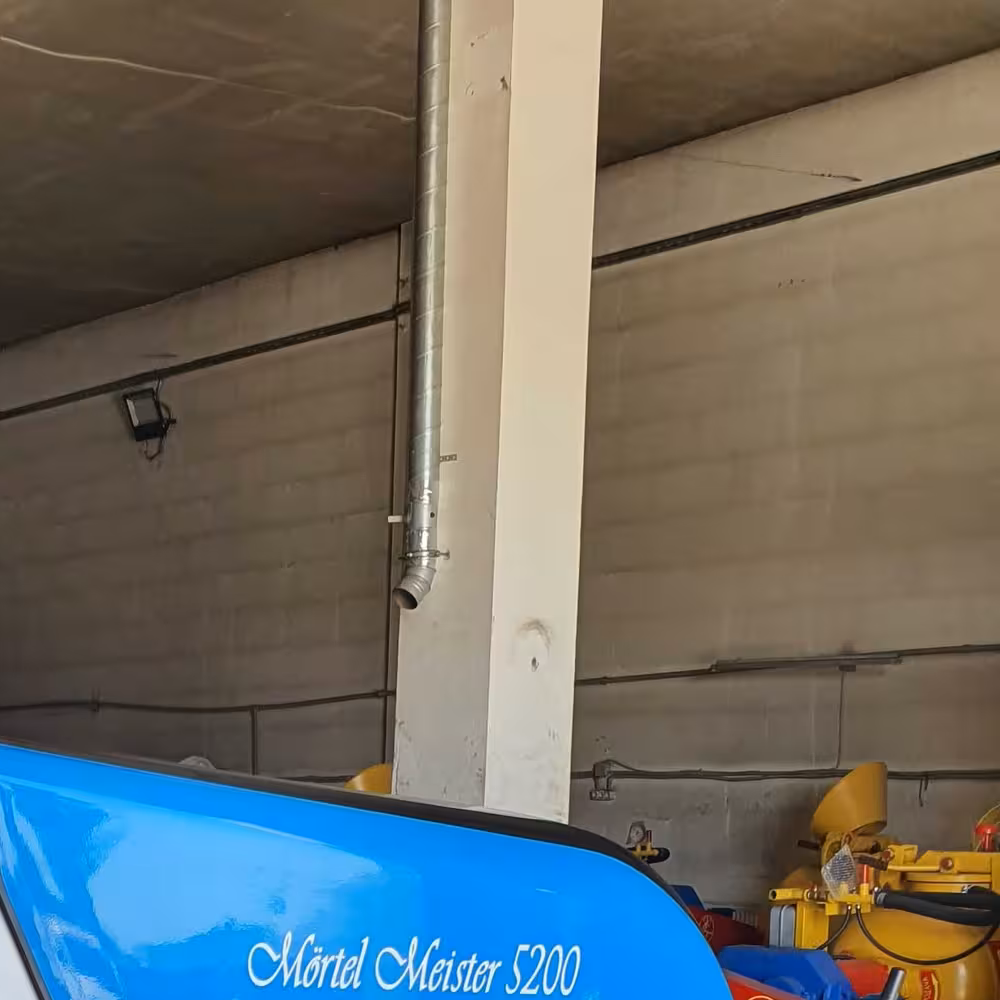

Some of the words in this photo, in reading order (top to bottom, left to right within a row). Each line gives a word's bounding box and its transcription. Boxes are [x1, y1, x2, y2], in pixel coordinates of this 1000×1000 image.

[248, 931, 369, 988] Mörtel
[375, 936, 502, 992] Meister
[505, 944, 581, 996] 5200
